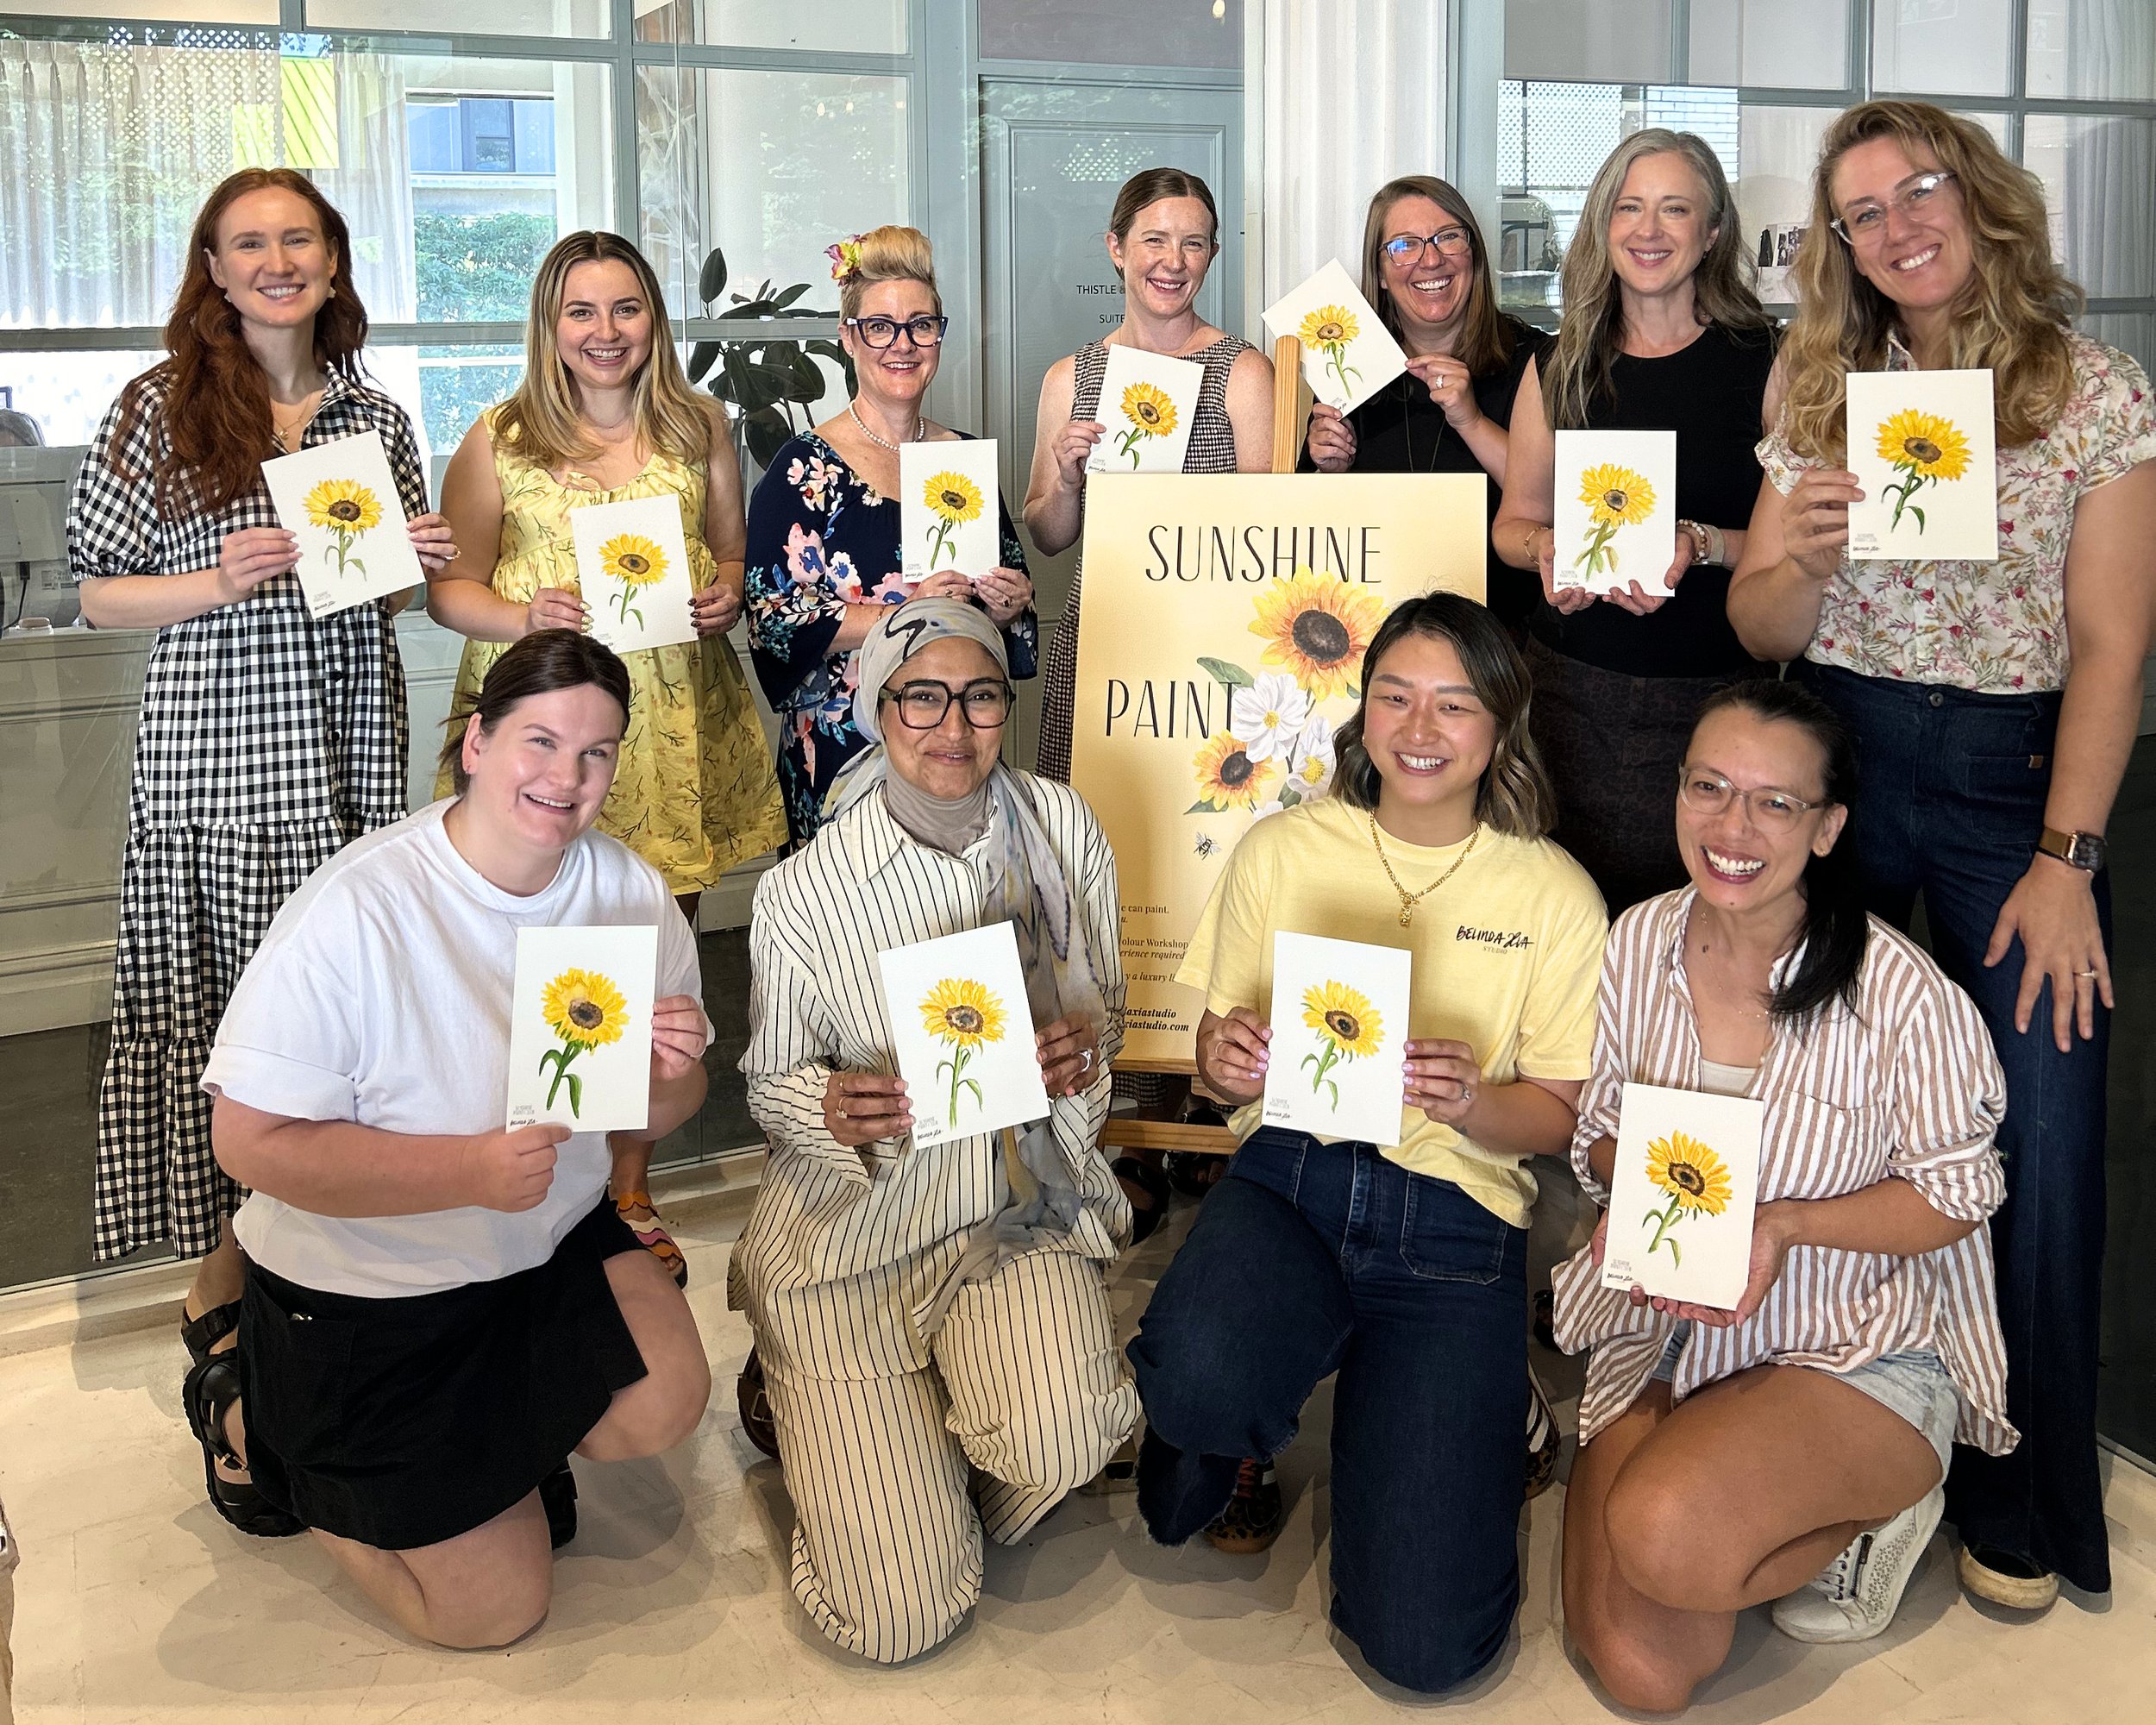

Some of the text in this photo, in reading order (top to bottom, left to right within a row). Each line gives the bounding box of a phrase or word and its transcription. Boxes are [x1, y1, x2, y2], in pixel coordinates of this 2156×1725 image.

[1076, 285, 1117, 294] THISTLE
[1145, 524, 1382, 583] SUNSHINE
[1106, 679, 1242, 739] PAINT
[1145, 905, 1169, 914] paint.
[1456, 925, 1506, 944] BELINDA
[1121, 938, 1189, 949] olour Workshop
[1119, 949, 1186, 960] erience required
[1139, 972, 1167, 982] luxury
[1125, 1007, 1177, 1018] axiastudio
[1125, 1019, 1189, 1032] xiastudio.com
